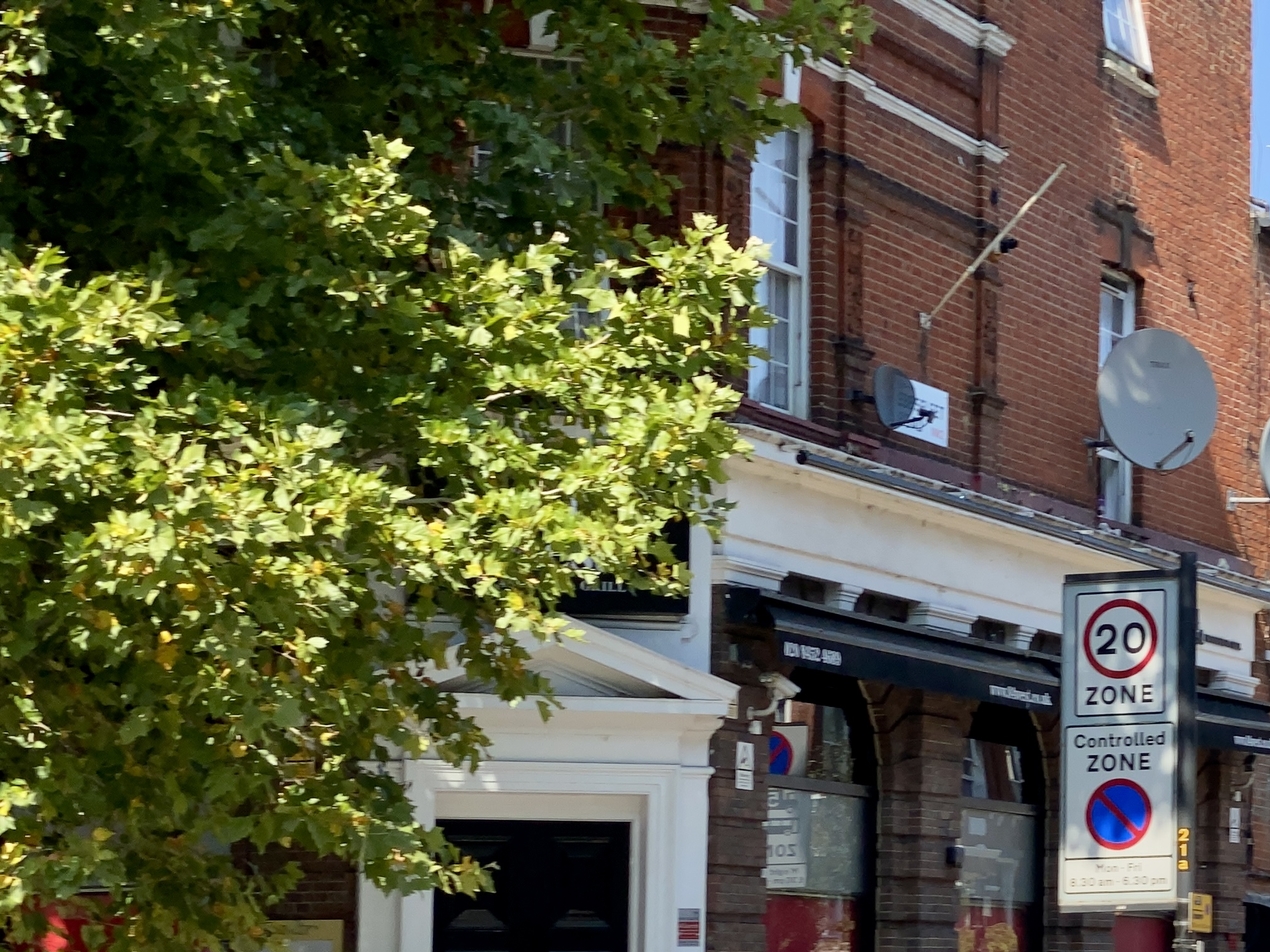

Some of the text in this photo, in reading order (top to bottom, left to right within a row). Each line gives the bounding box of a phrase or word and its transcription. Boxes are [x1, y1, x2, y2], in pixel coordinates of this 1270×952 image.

[1095, 622, 1146, 655] 20
[1086, 684, 1154, 706] ZONE
[1074, 731, 1166, 749] Controlled
[1087, 752, 1151, 772] ZONE
[1095, 863, 1119, 873] Mon
[1127, 862, 1142, 872] Fri
[1098, 879, 1114, 887] am
[1151, 877, 1168, 886] pm
